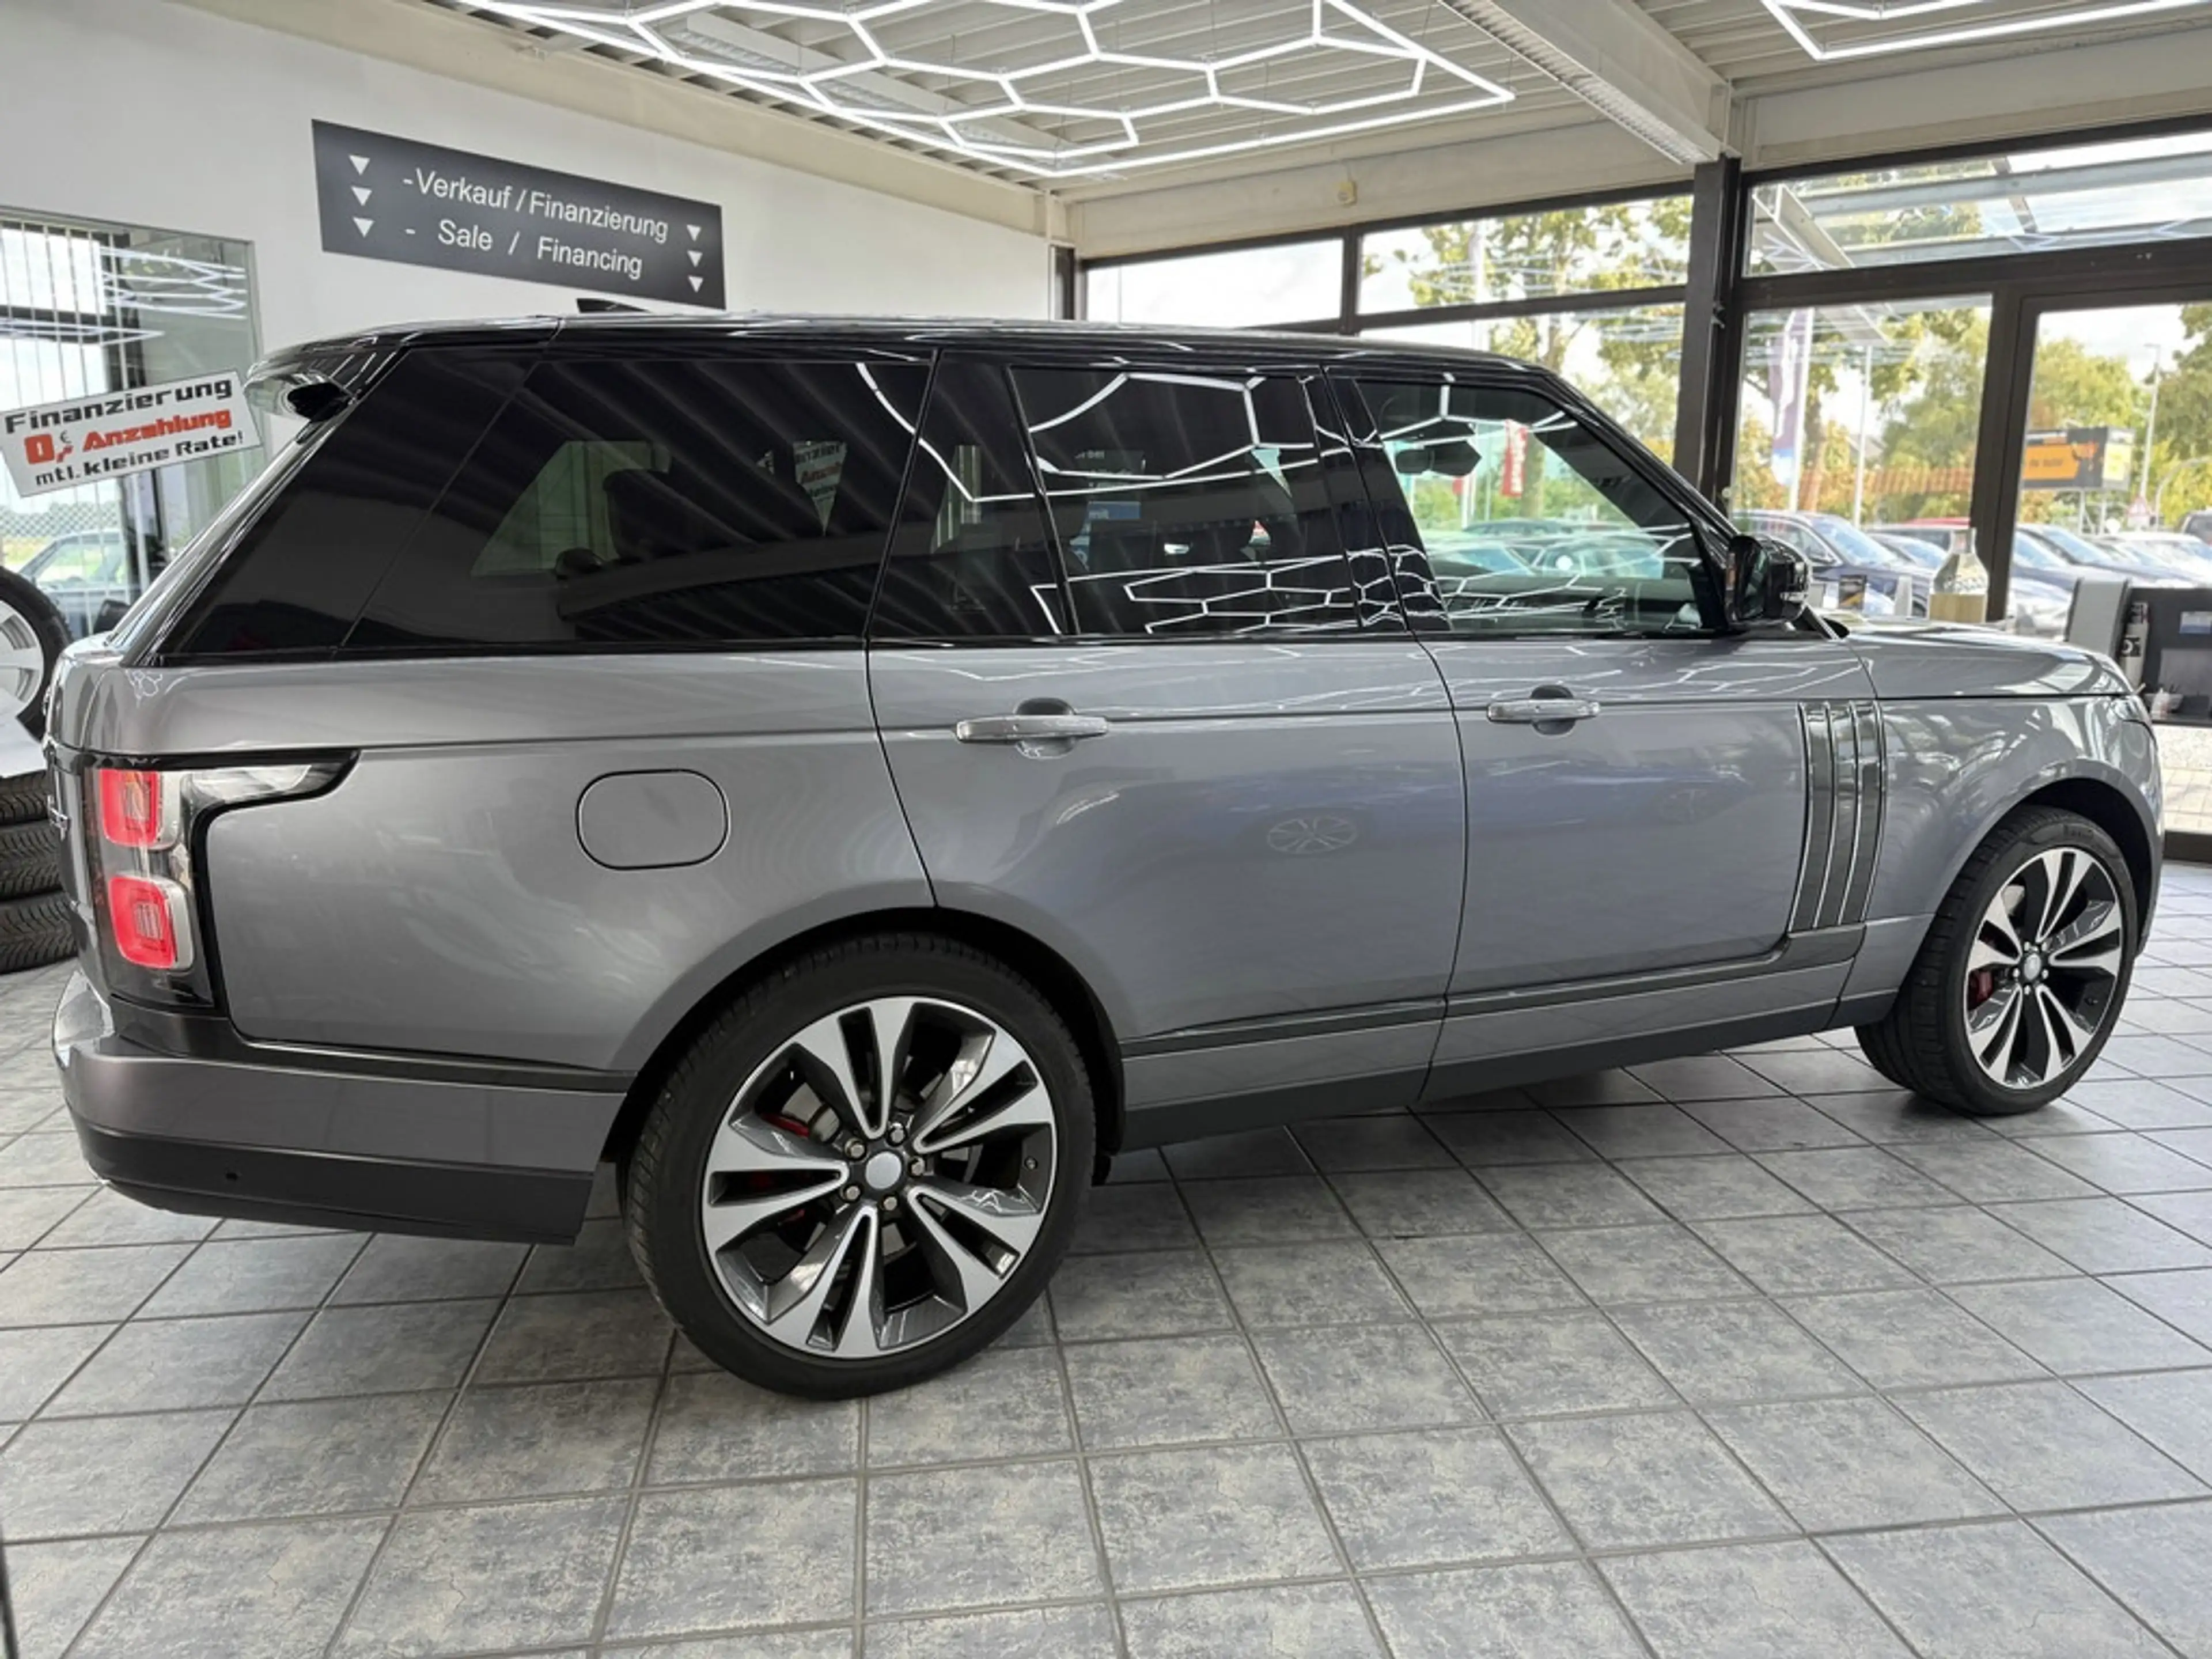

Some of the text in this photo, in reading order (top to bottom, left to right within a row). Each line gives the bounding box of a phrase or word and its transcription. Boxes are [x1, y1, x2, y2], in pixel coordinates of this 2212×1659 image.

[438, 218, 494, 251] Sale
[537, 236, 643, 280] Financing
[5, 379, 233, 434] Finanzierung
[83, 409, 232, 452] Anzahlung
[84, 448, 169, 476] kleine
[175, 430, 245, 457] Rate!
